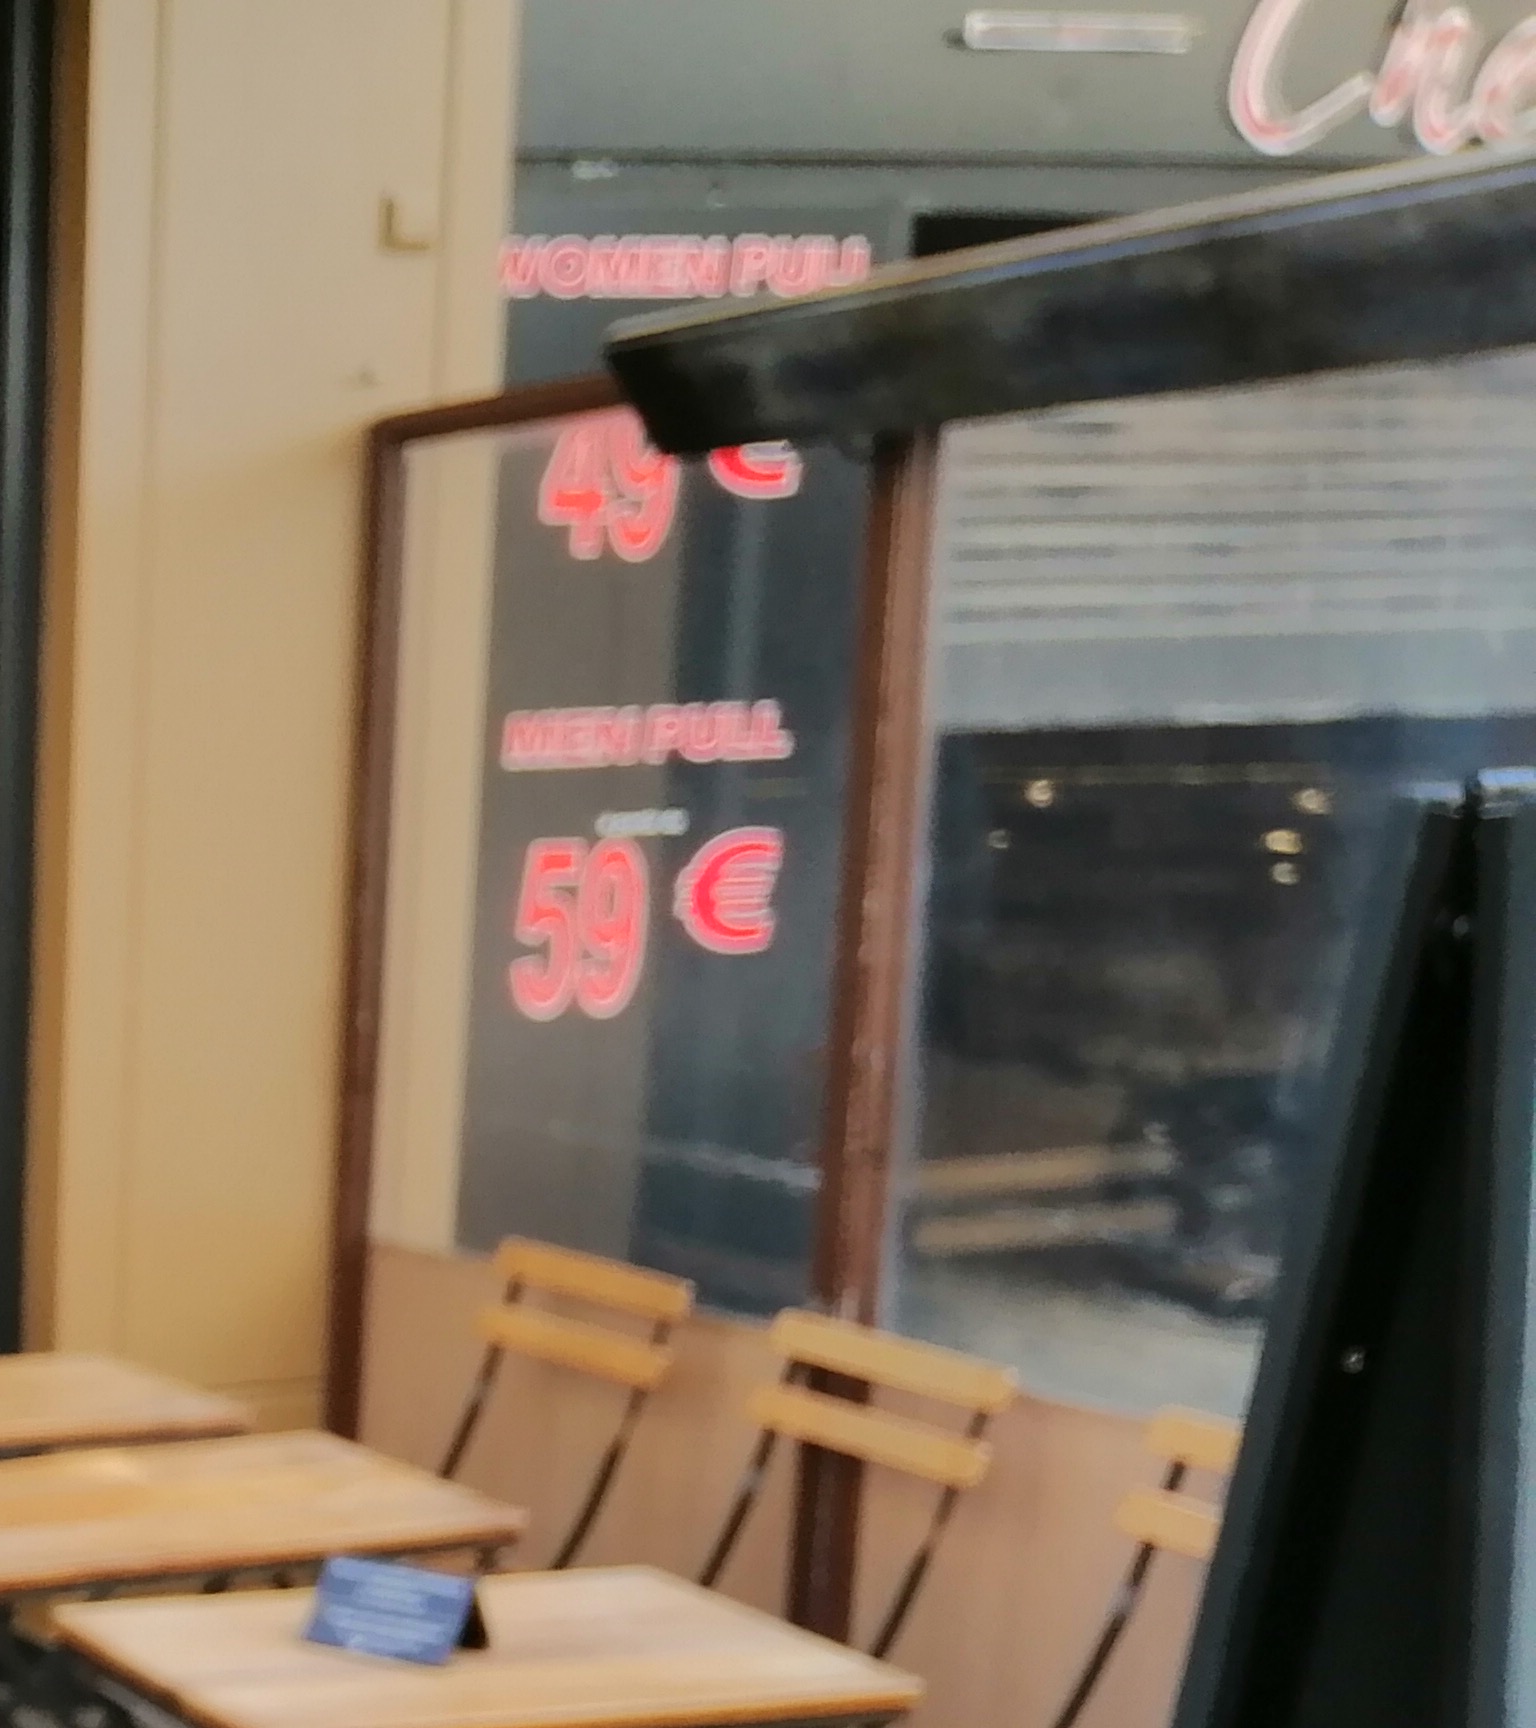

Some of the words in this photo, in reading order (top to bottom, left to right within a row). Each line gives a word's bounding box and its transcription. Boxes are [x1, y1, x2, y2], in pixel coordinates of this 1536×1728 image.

[500, 704, 642, 771] MEN
[642, 699, 796, 765] PULL
[509, 837, 650, 1022] 59
